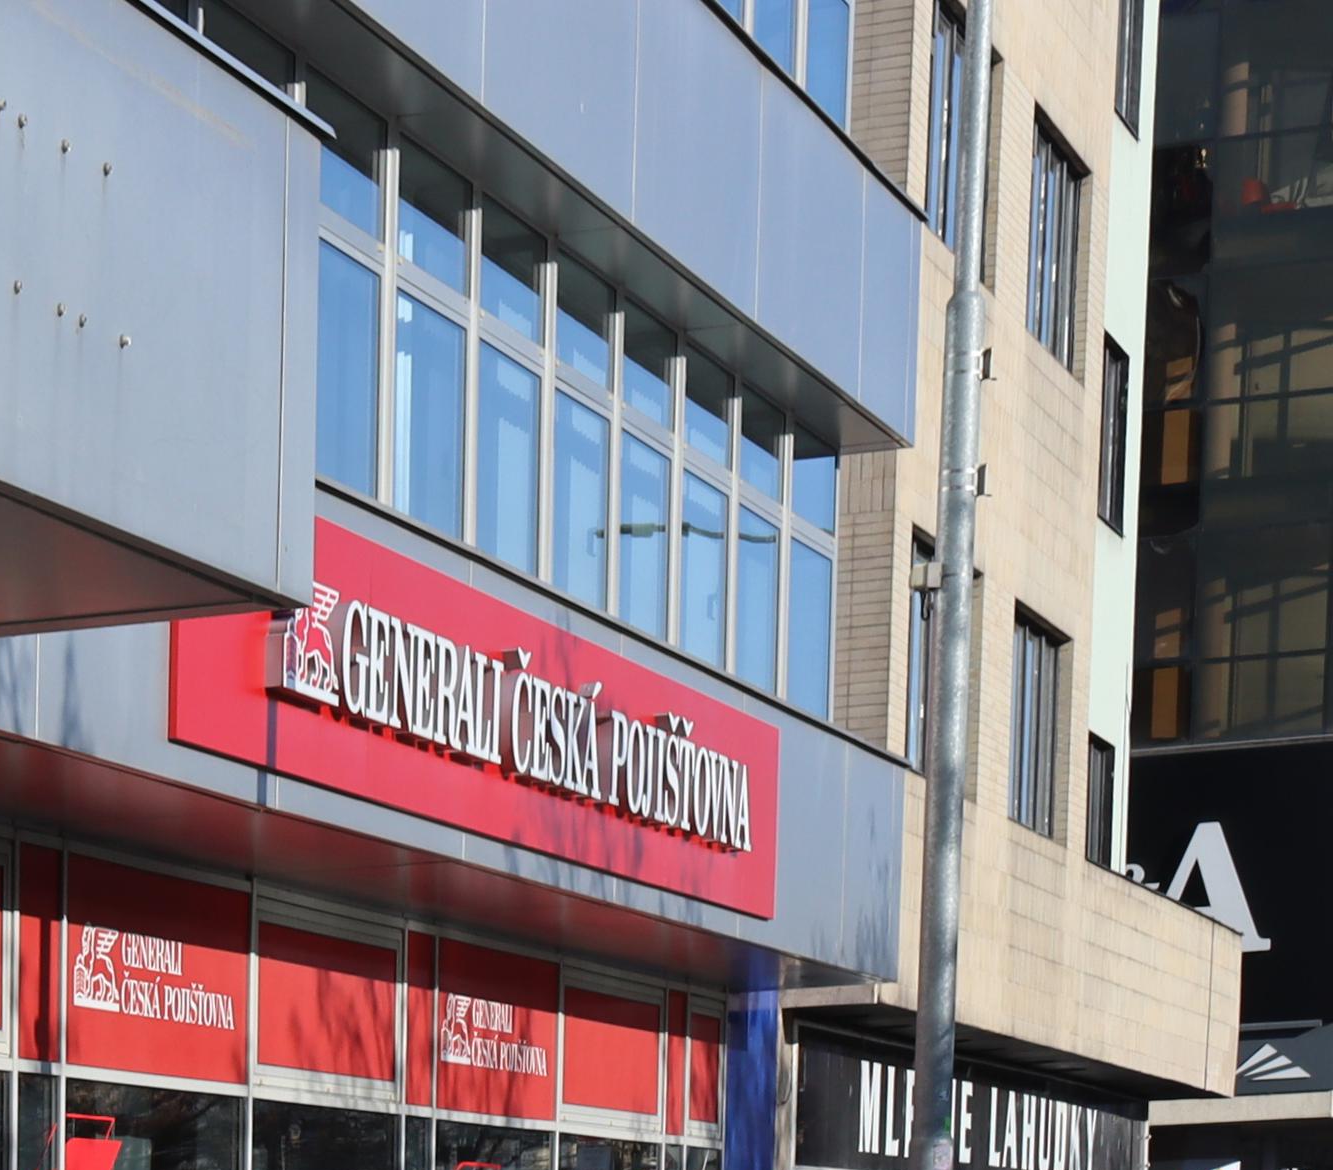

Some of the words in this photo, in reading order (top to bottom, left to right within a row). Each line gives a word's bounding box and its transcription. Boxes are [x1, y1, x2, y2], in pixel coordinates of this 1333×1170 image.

[342, 600, 506, 764] GENERALI
[511, 646, 602, 800] ČESKÁ
[608, 710, 752, 853] POJIŠŤOVNA
[121, 932, 183, 976] GENERALI
[121, 972, 160, 1018] ČESKÁ
[163, 979, 234, 1031] POJIŠŤOVNA
[472, 998, 513, 1034] GENERALI
[472, 1030, 498, 1070] ČESKÁ
[500, 1039, 547, 1077] POJIŠŤOVNA
